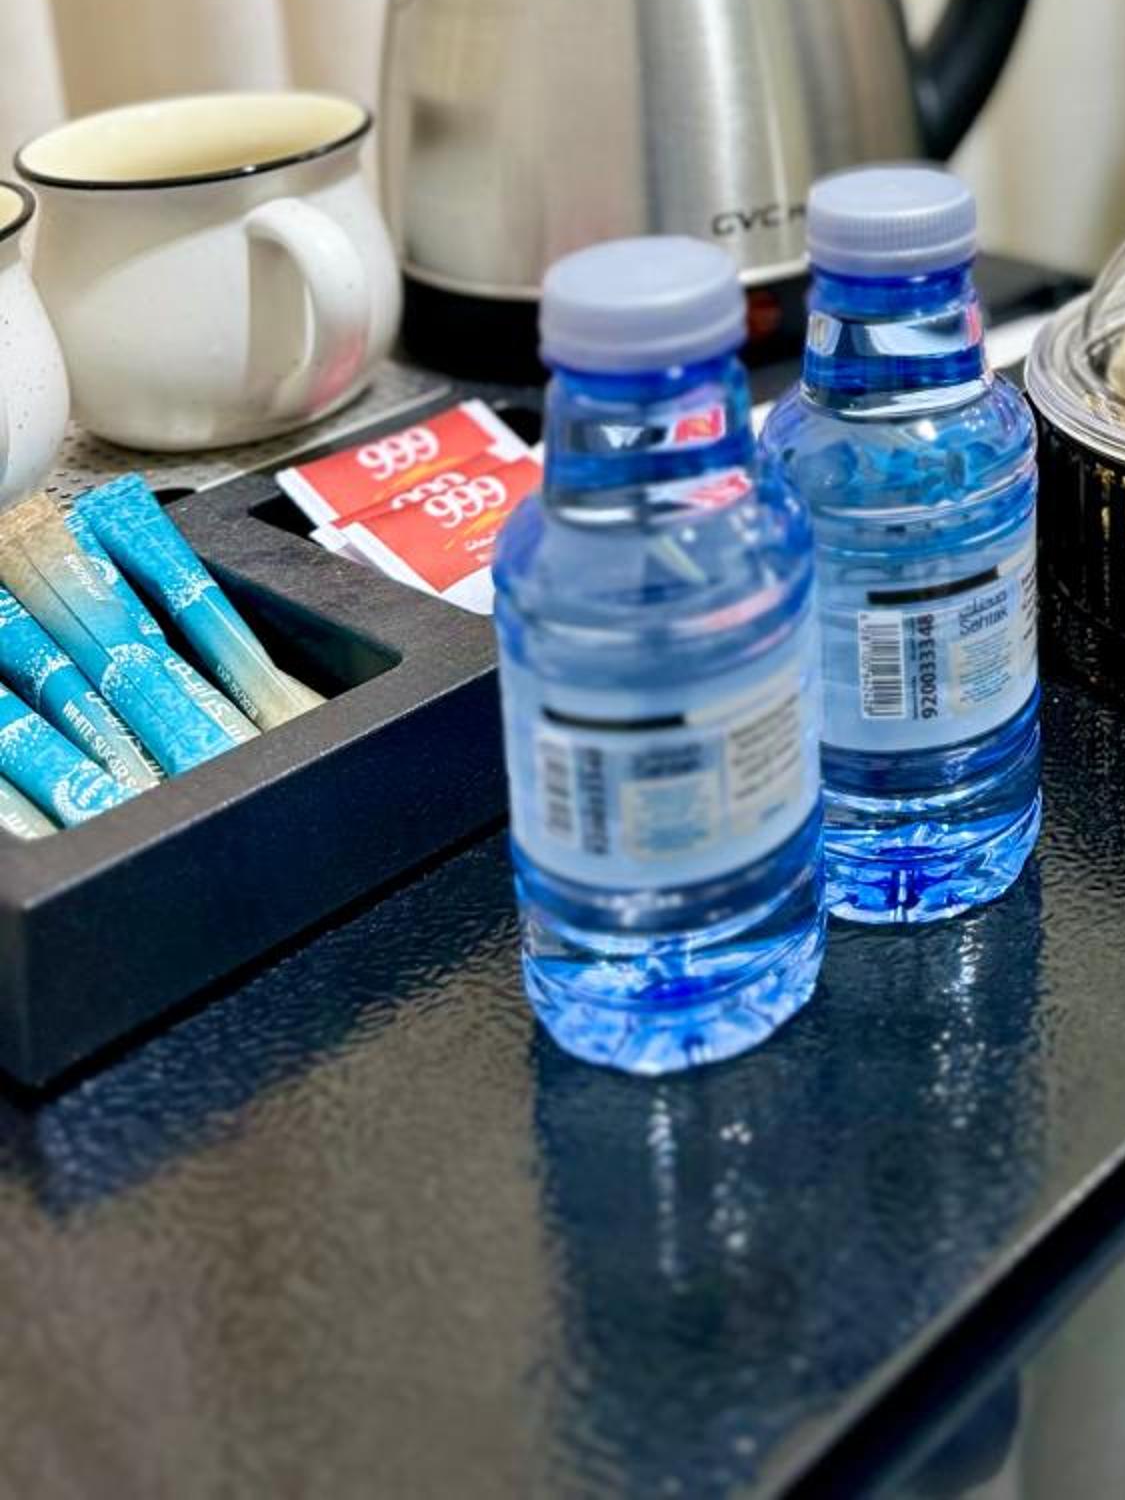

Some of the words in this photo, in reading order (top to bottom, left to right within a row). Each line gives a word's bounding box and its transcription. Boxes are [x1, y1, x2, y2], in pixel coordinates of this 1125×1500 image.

[356, 426, 440, 481] 999
[423, 475, 506, 529] 999
[62, 700, 98, 743] WHITE
[91, 735, 129, 784] SUGAR
